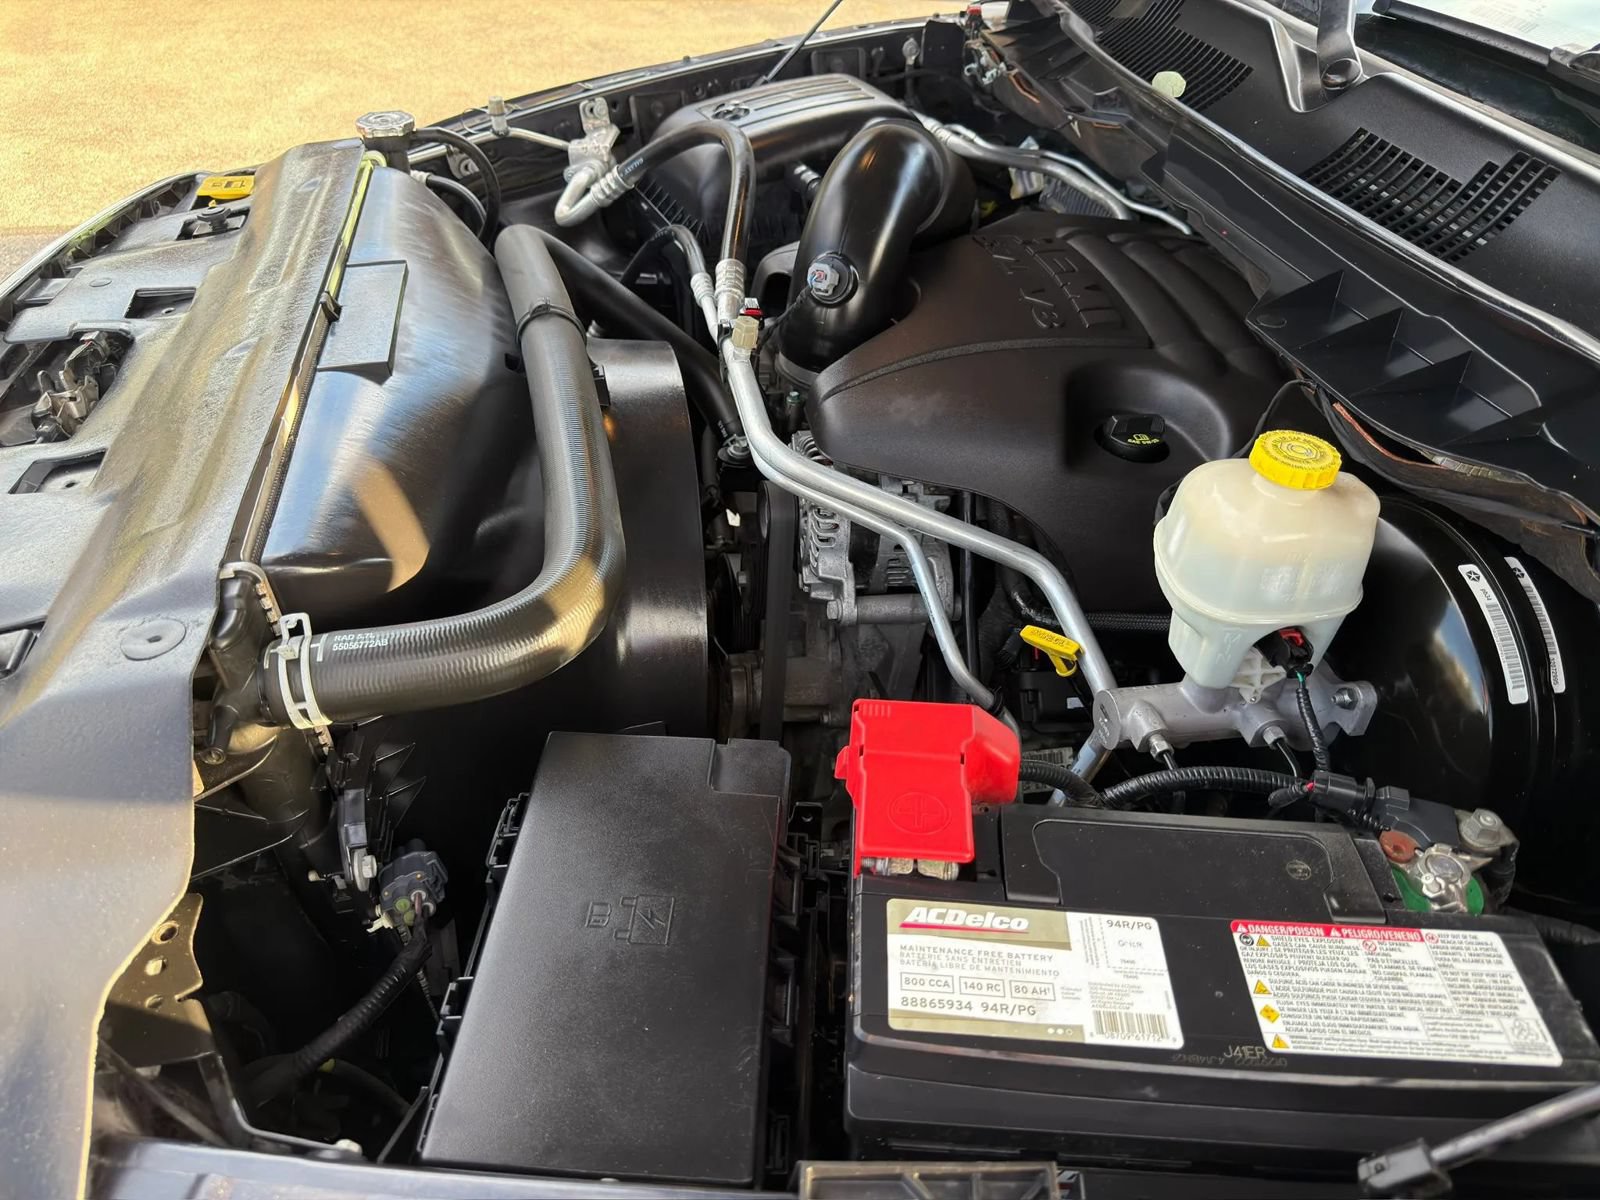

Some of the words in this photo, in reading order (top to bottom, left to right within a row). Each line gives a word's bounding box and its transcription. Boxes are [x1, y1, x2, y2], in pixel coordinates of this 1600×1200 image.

[334, 634, 355, 642] RAD
[904, 906, 1030, 931] ACDelco
[1106, 919, 1153, 931] 94R/PG
[1247, 924, 1325, 937] DANGER/POISON
[1341, 928, 1421, 942] PELIGRO/VENENO
[900, 944, 974, 957] MAINTENANCE
[977, 949, 1003, 958] FREE
[1007, 952, 1054, 962] BATTERY
[900, 952, 944, 961] BATTERIE
[945, 954, 968, 962] SANS
[972, 957, 1022, 966] ENTRETIEN
[940, 961, 966, 970] LIBRE
[984, 965, 1060, 977] MANTENIMIENTO
[904, 977, 925, 986] 800
[929, 979, 950, 988] CCA
[963, 981, 983, 991] 140
[987, 983, 1001, 992] RC
[1014, 985, 1028, 994] 80
[901, 996, 973, 1011] 88865934
[981, 1001, 1037, 1016] 94R/PG
